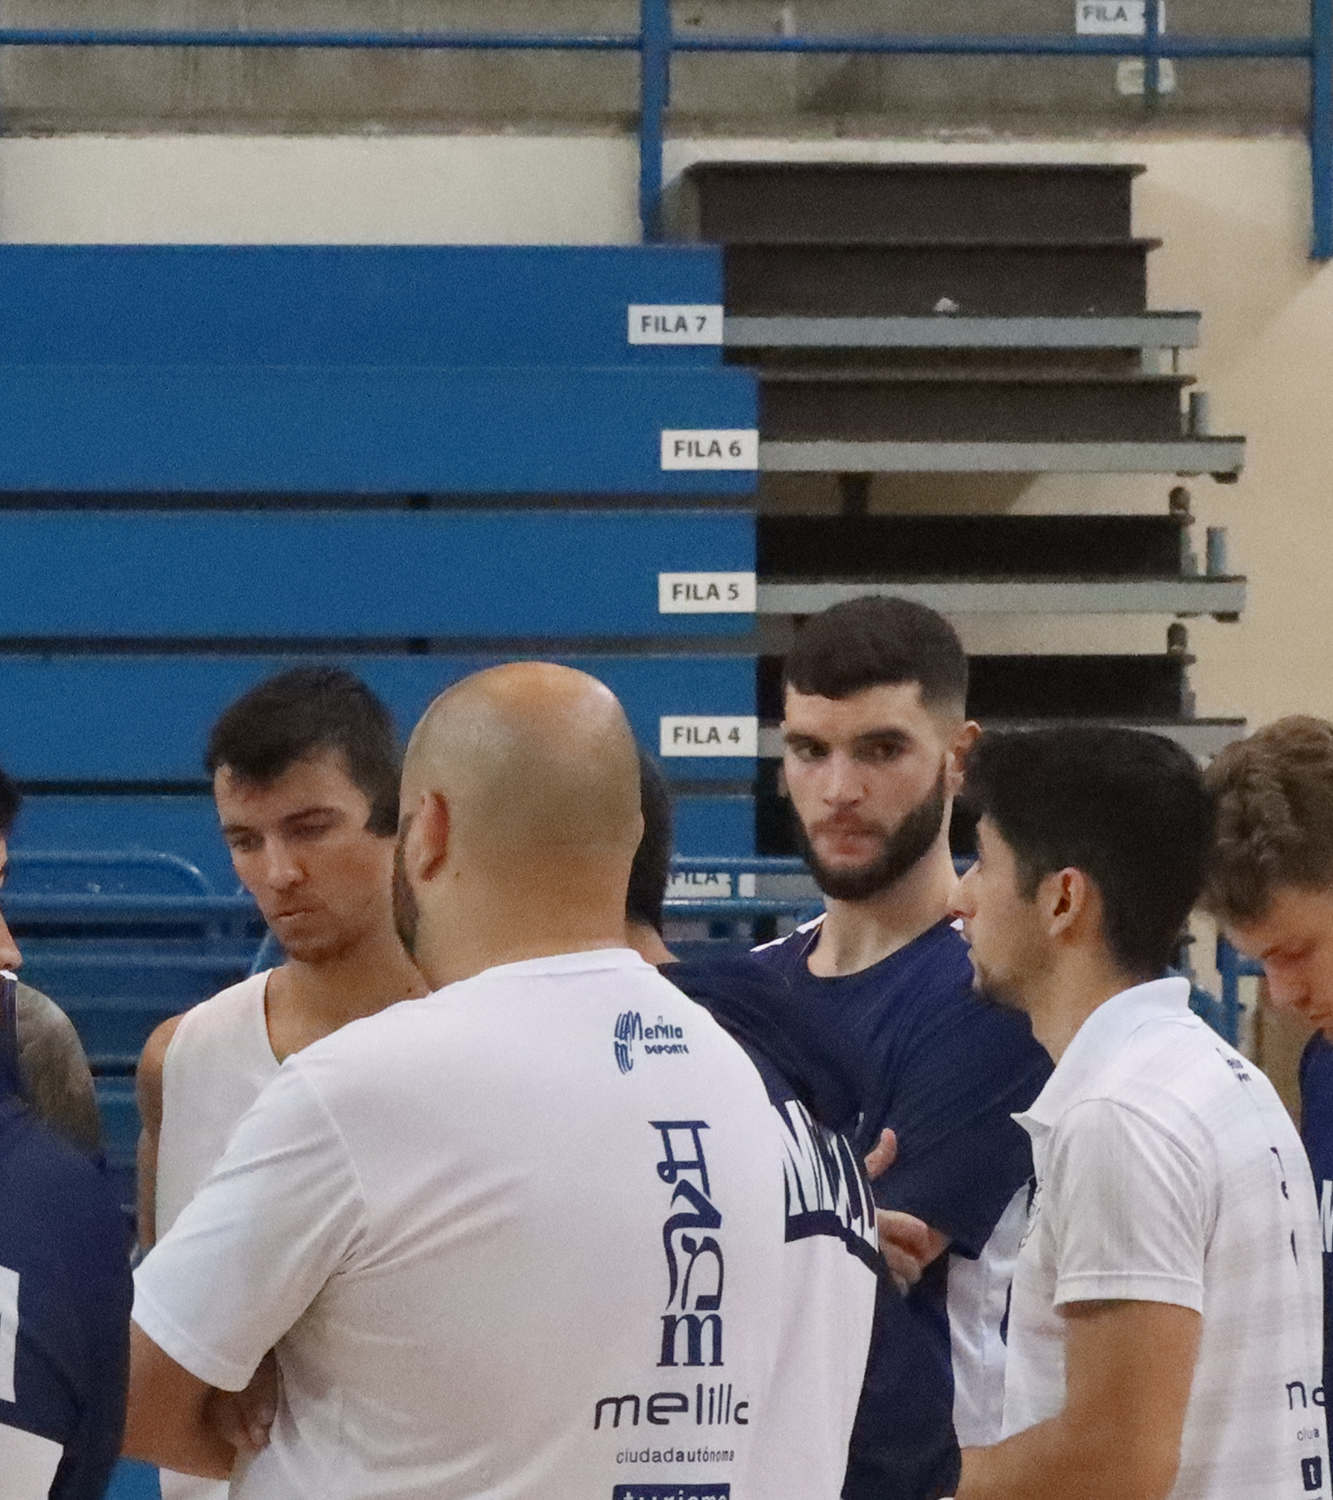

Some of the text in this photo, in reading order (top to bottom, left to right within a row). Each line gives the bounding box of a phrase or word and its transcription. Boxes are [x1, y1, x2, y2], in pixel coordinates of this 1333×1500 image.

[1082, 5, 1128, 22] FILA
[641, 315, 707, 333] FILA 7
[674, 439, 741, 458] FILA 6
[672, 583, 739, 601] FILA 5
[673, 726, 740, 744] FILA 4
